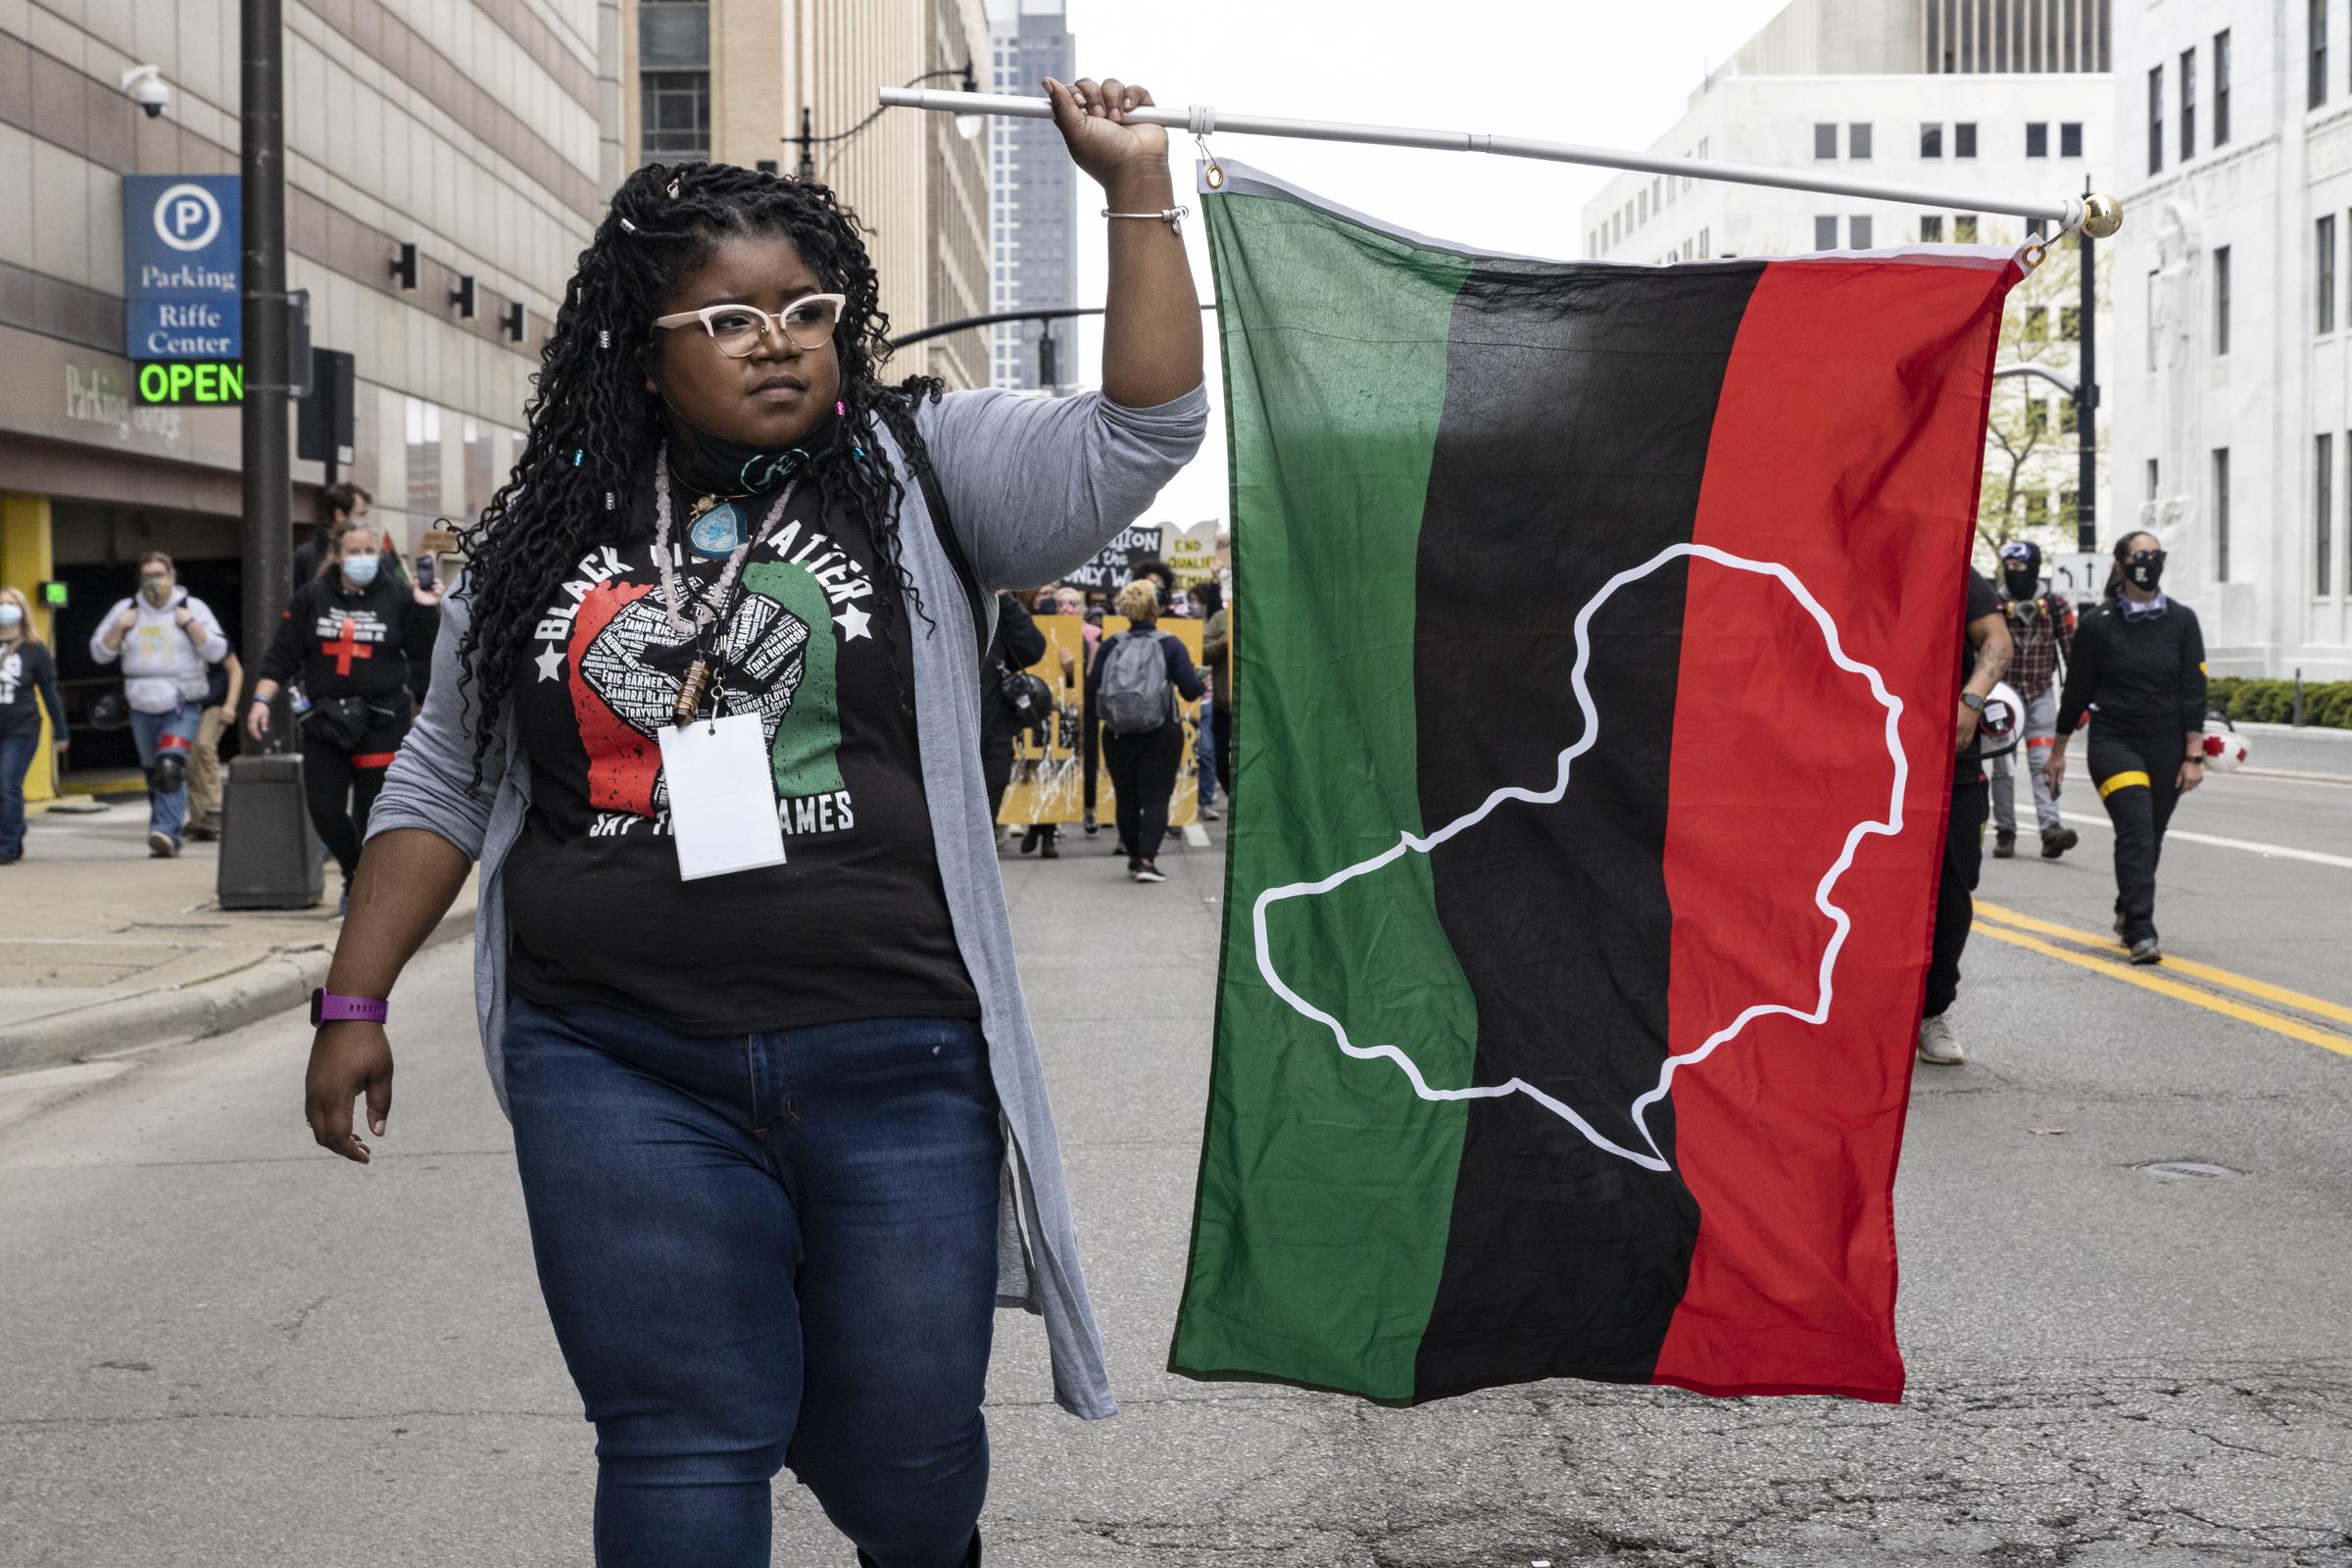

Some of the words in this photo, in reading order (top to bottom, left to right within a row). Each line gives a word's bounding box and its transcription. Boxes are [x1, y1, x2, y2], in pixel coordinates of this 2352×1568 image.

[142, 265, 236, 292] Parking
[159, 305, 221, 327] Riffe
[147, 330, 231, 354] Center
[139, 364, 243, 402] OPEN
[1174, 539, 1201, 552] END
[534, 545, 635, 640] BLACK
[760, 518, 873, 605] ATTER
[617, 629, 644, 643] TANISHA
[644, 634, 679, 648] ANDERSON
[623, 618, 653, 633] TAMIR
[654, 623, 677, 638] RICE
[602, 632, 627, 658] FREDDIE
[621, 652, 641, 670] GRAY
[747, 652, 770, 674] TONY
[765, 627, 808, 660] ROBINSON
[602, 669, 623, 685] ERIC
[624, 671, 663, 689] GARNER
[605, 685, 643, 702] SANDRA
[731, 697, 764, 715] GEORGE
[763, 687, 791, 705] FLOYD
[770, 697, 792, 710] SCOTT
[625, 706, 663, 718] TRAYVON
[590, 811, 644, 837] SAY
[778, 790, 855, 835] AMES
